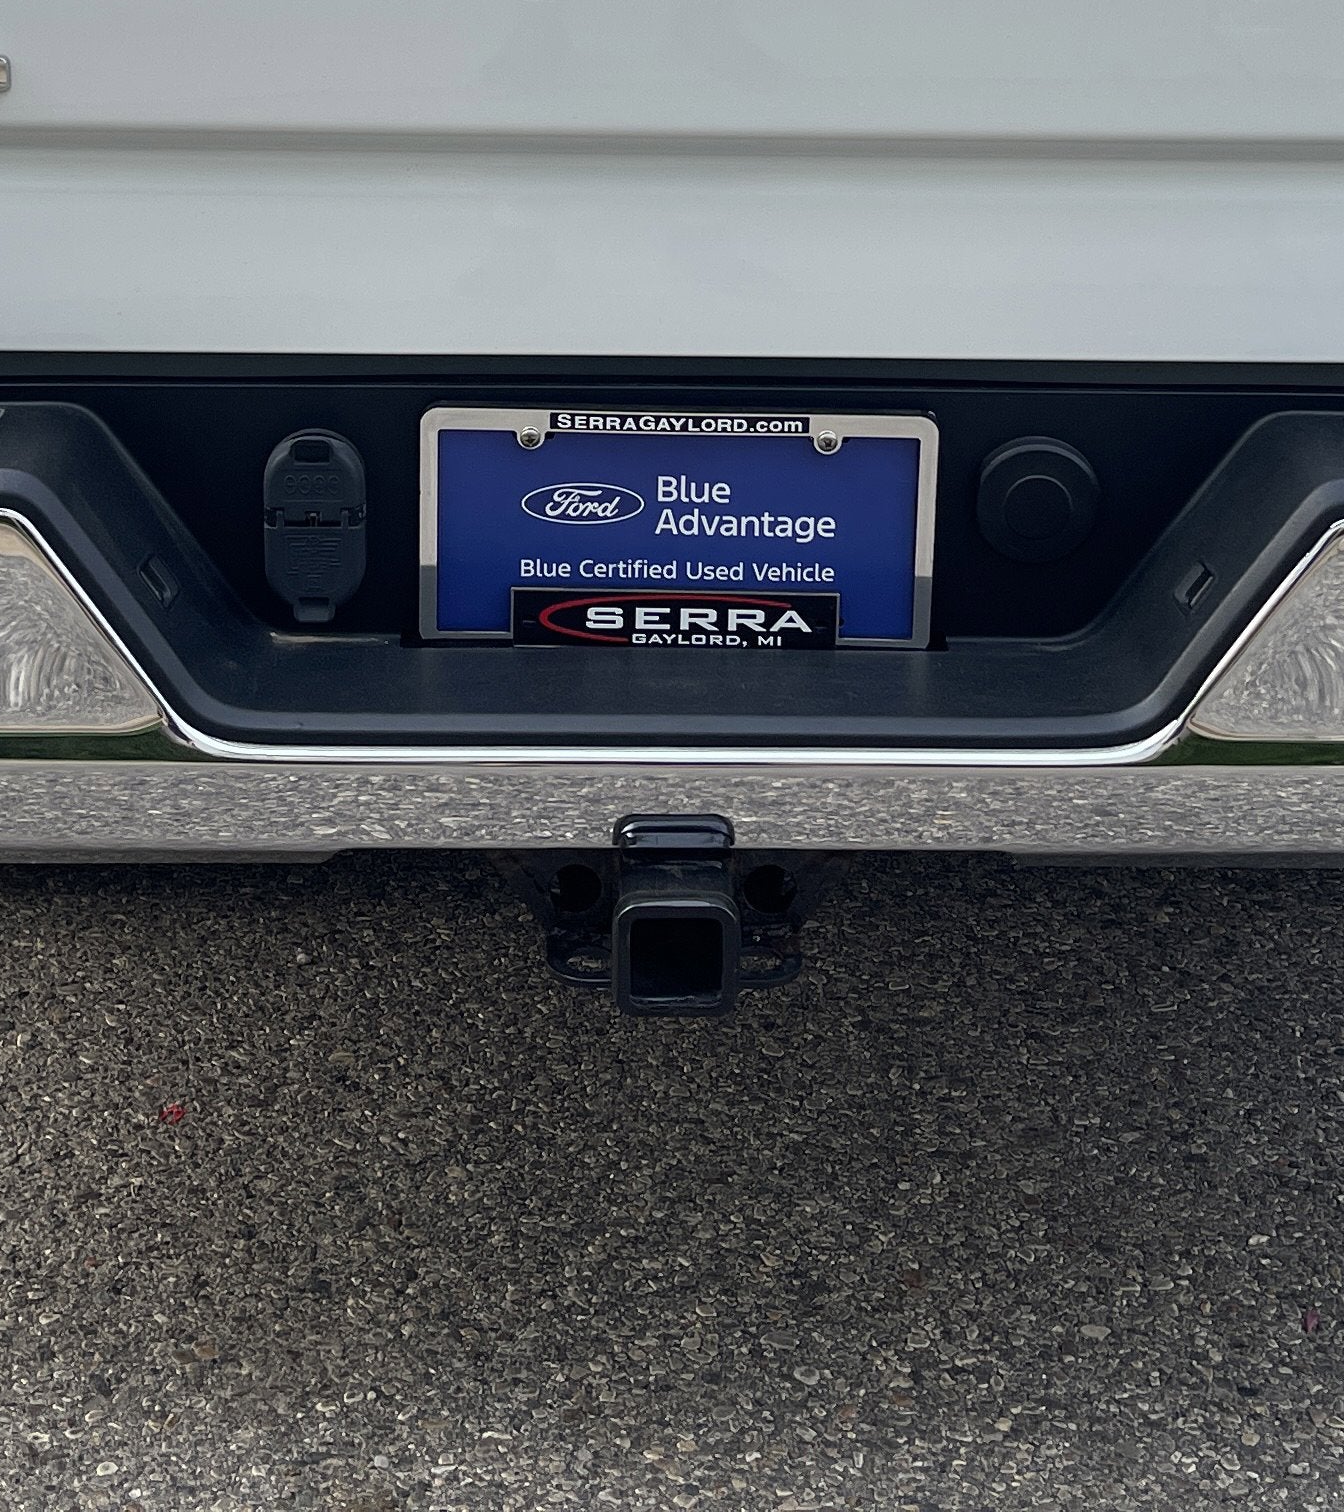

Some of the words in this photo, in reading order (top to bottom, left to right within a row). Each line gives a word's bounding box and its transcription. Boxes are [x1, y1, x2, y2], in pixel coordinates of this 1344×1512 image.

[556, 413, 804, 434] SERRAGAYLORD.com
[544, 488, 621, 518] Ford
[656, 475, 732, 504] Blue
[654, 508, 837, 543] Advantage
[519, 558, 571, 578] Blue
[579, 559, 677, 580] Certified
[686, 561, 744, 581] Used
[752, 562, 836, 582] Vehicle
[585, 606, 813, 633] SERRA
[631, 633, 748, 648] GAYLORD,
[757, 636, 783, 647] MI
